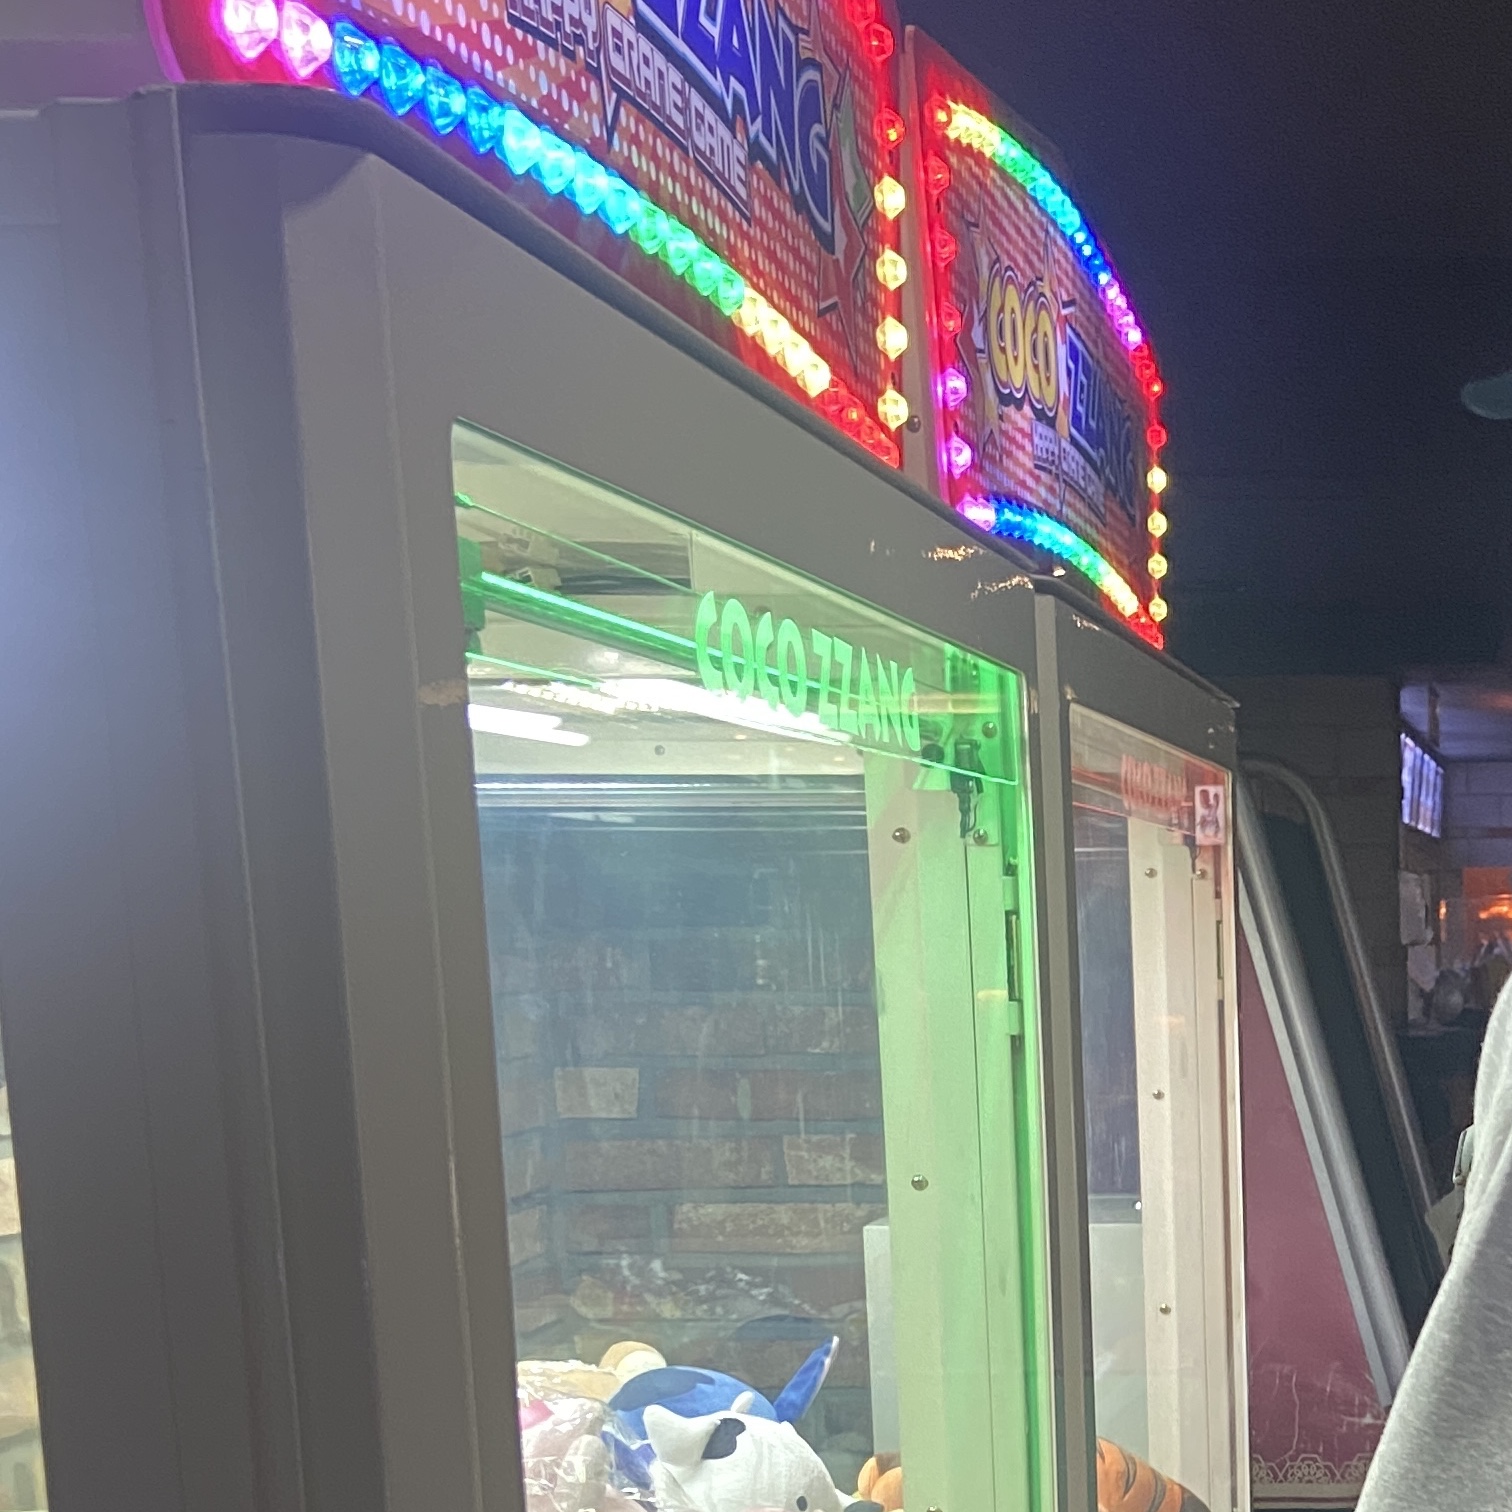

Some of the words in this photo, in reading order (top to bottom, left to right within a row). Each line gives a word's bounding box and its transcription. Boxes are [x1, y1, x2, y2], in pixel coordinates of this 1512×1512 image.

[634, 0, 833, 234] ANG
[689, 86, 750, 205] GAME
[989, 264, 1058, 415] COCO
[695, 590, 808, 717] COCO
[811, 628, 920, 751] ZZANG
